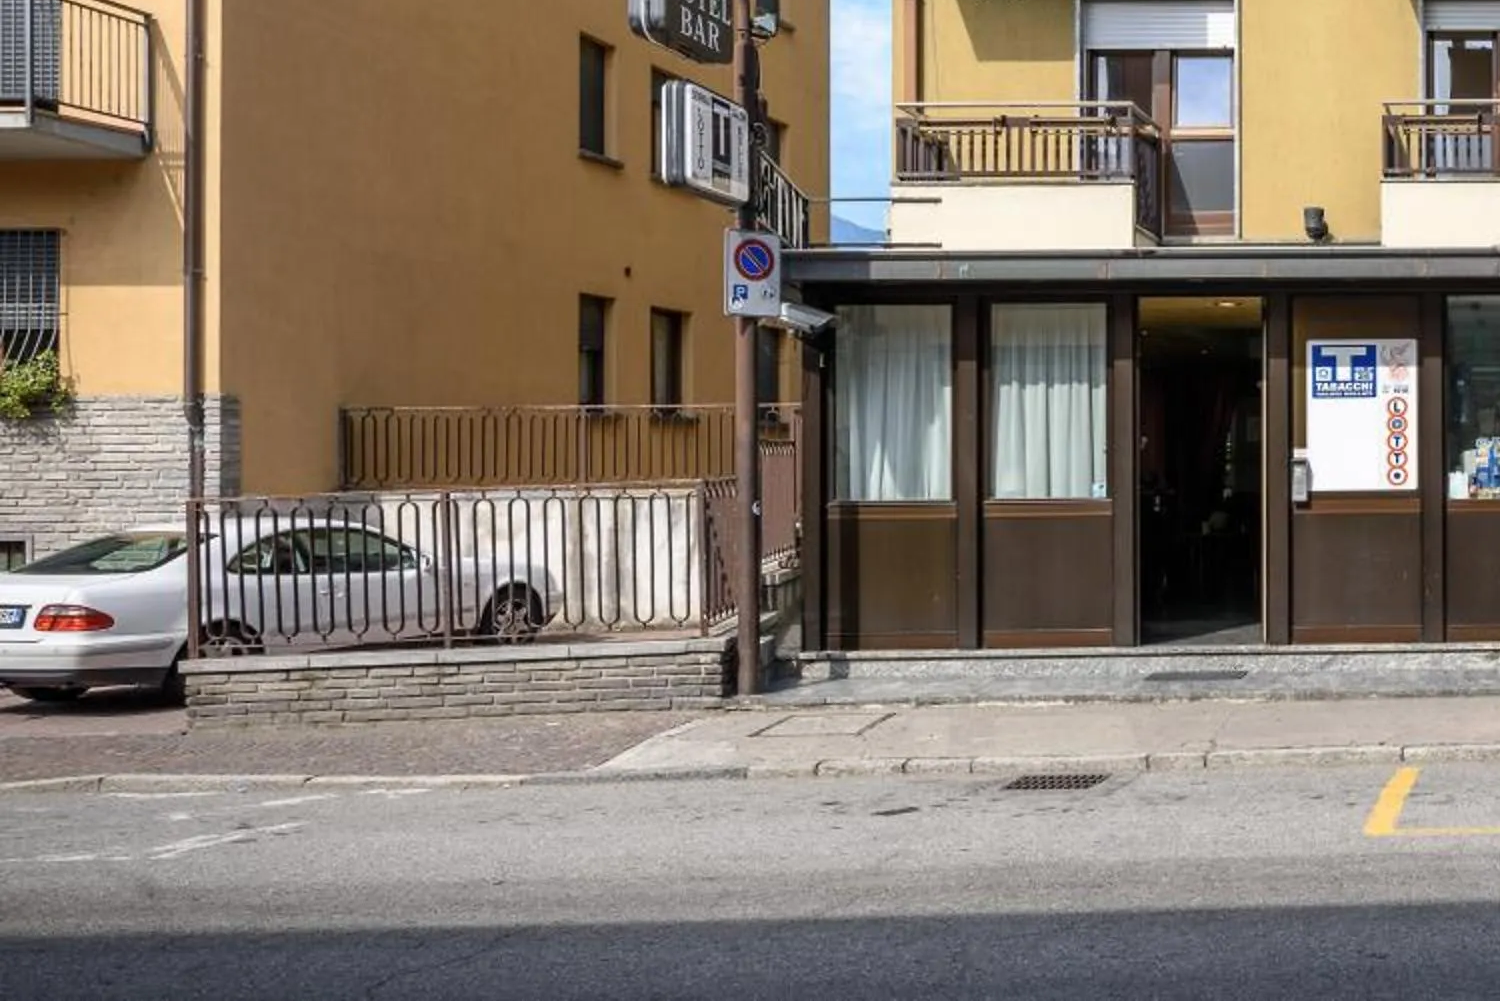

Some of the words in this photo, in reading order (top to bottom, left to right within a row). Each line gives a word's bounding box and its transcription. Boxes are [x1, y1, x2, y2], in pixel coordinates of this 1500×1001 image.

[680, 5, 720, 52] BAR
[713, 102, 730, 156] T
[1315, 382, 1374, 392] TABACCHI
[1321, 346, 1367, 381] T
[1389, 399, 1406, 483] LOTTO
